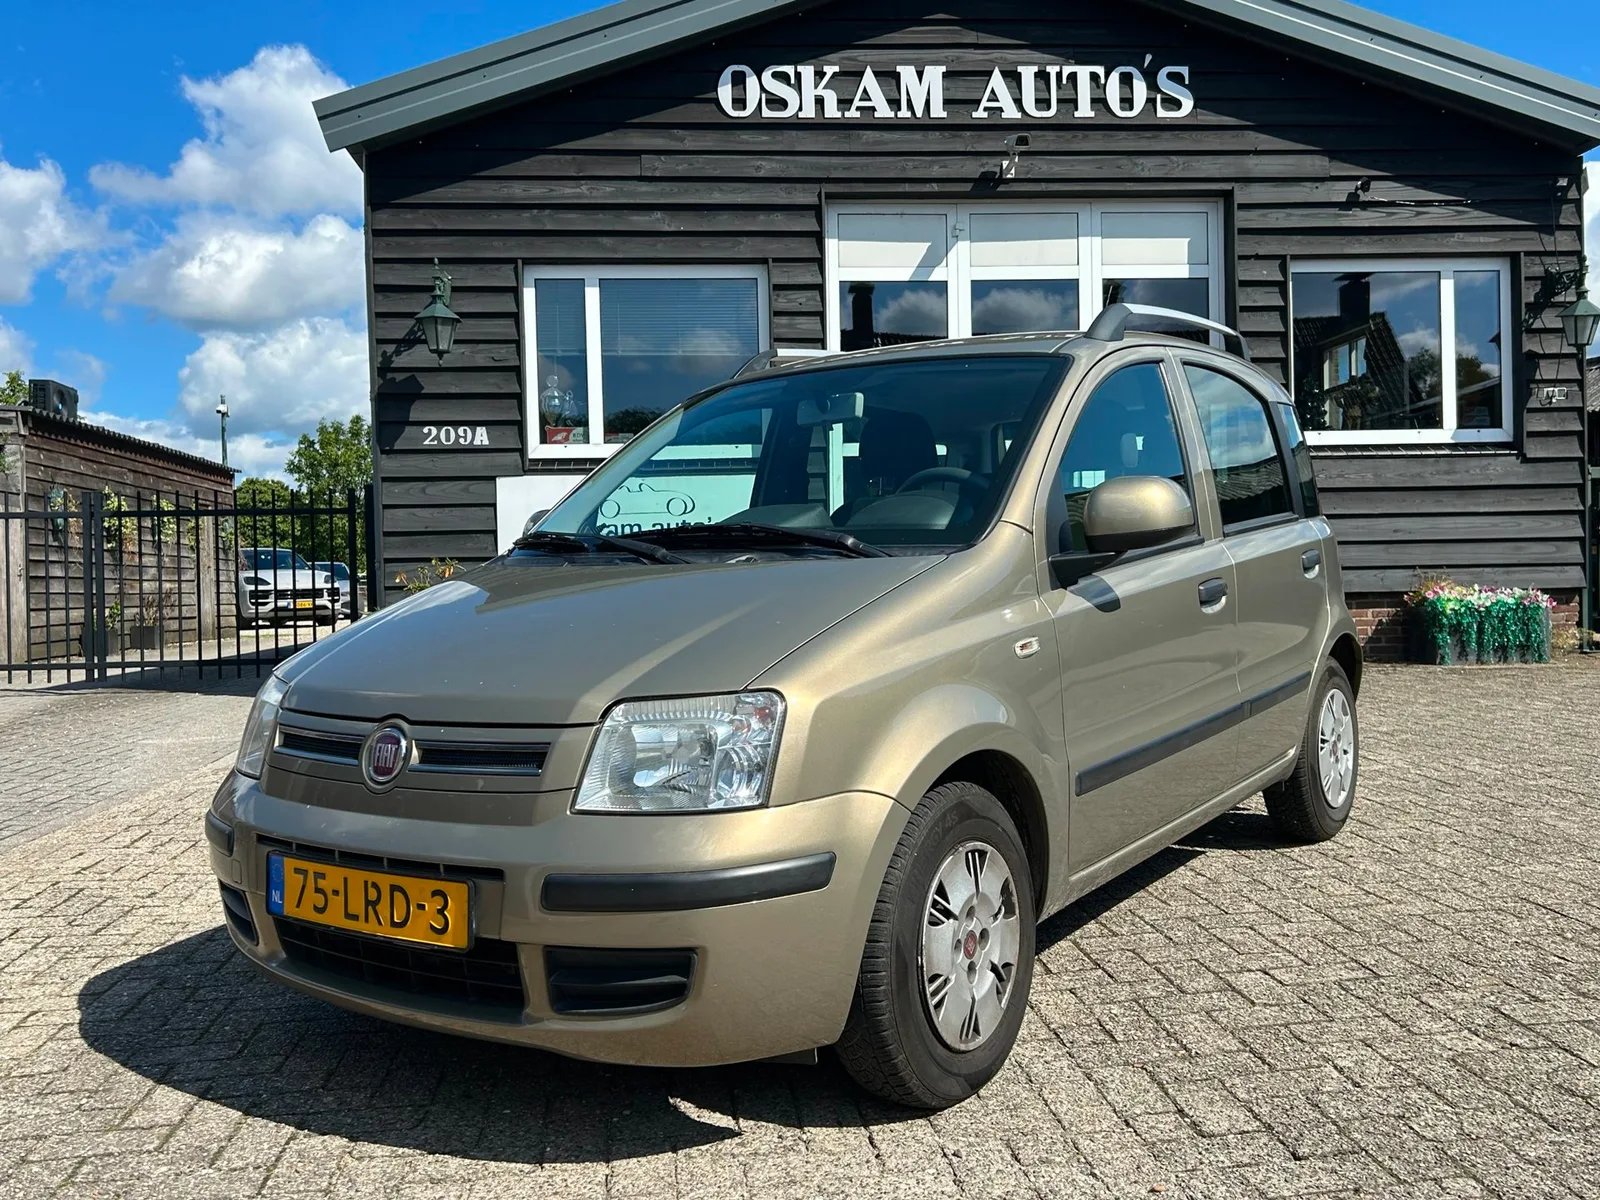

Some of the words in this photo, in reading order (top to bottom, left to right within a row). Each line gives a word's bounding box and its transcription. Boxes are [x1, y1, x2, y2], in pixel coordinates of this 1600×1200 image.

[717, 64, 948, 118] OSKAM
[972, 53, 1195, 118] AUTO'S
[422, 425, 490, 445] 209A
[374, 743, 399, 768] FIAT
[271, 889, 283, 904] NL
[292, 867, 451, 936] 75-LRD-3
